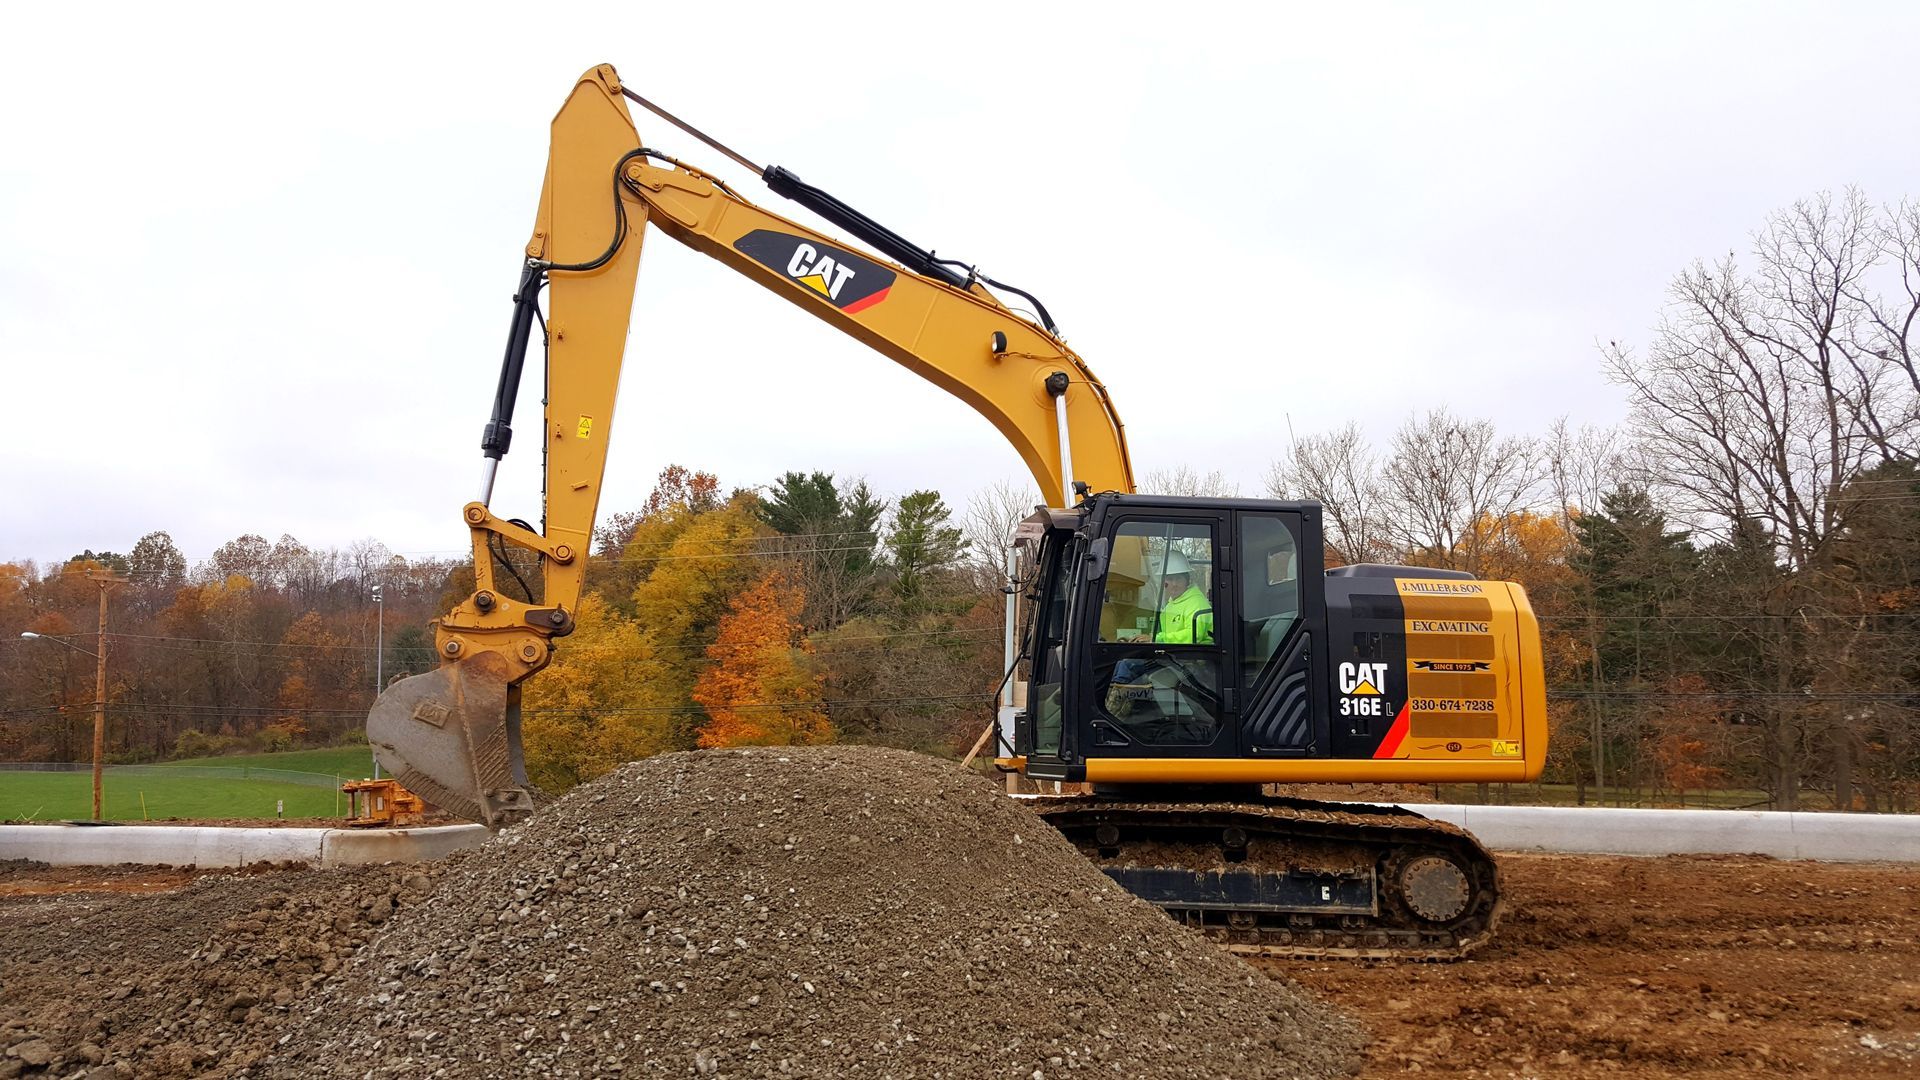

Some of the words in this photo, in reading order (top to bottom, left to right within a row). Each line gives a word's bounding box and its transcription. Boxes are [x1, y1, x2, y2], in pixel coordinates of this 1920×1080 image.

[788, 243, 855, 300] CAT
[1452, 584, 1459, 592] &
[1460, 584, 1483, 593] SON
[1412, 621, 1488, 632] EXCAVATING
[1339, 662, 1388, 694] CAT
[1340, 697, 1382, 716] 316E
[1385, 702, 1394, 717] L
[1447, 744, 1460, 752] 69
